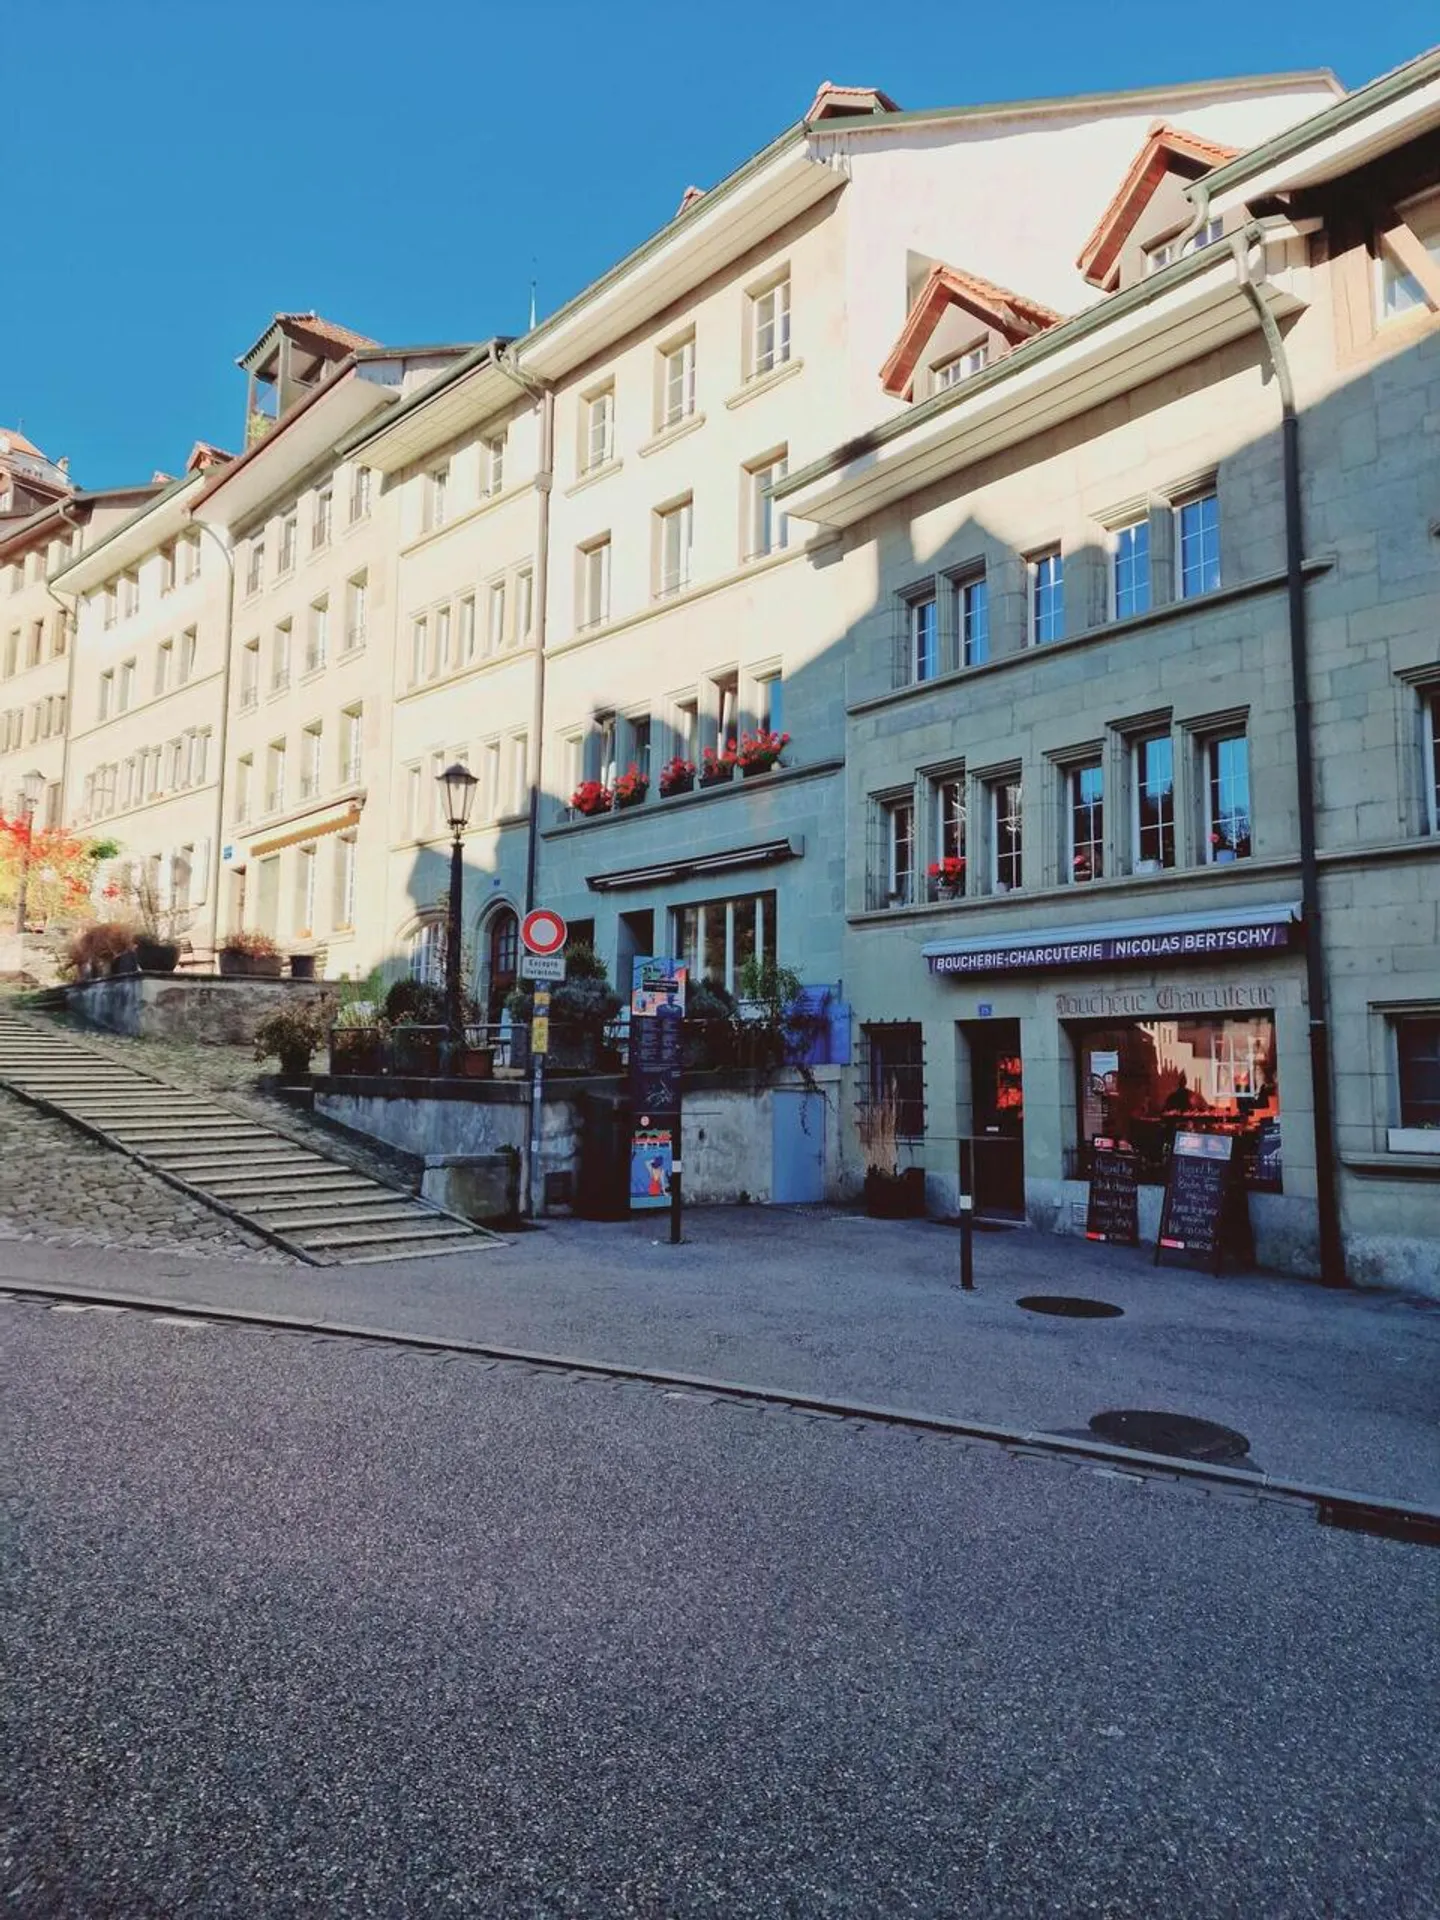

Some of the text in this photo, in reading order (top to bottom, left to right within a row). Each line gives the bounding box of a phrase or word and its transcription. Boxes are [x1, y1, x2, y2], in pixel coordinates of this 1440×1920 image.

[936, 927, 1272, 971] BOUCHERIE-CHARCUTERIE NICOLAS BERTSCHY
